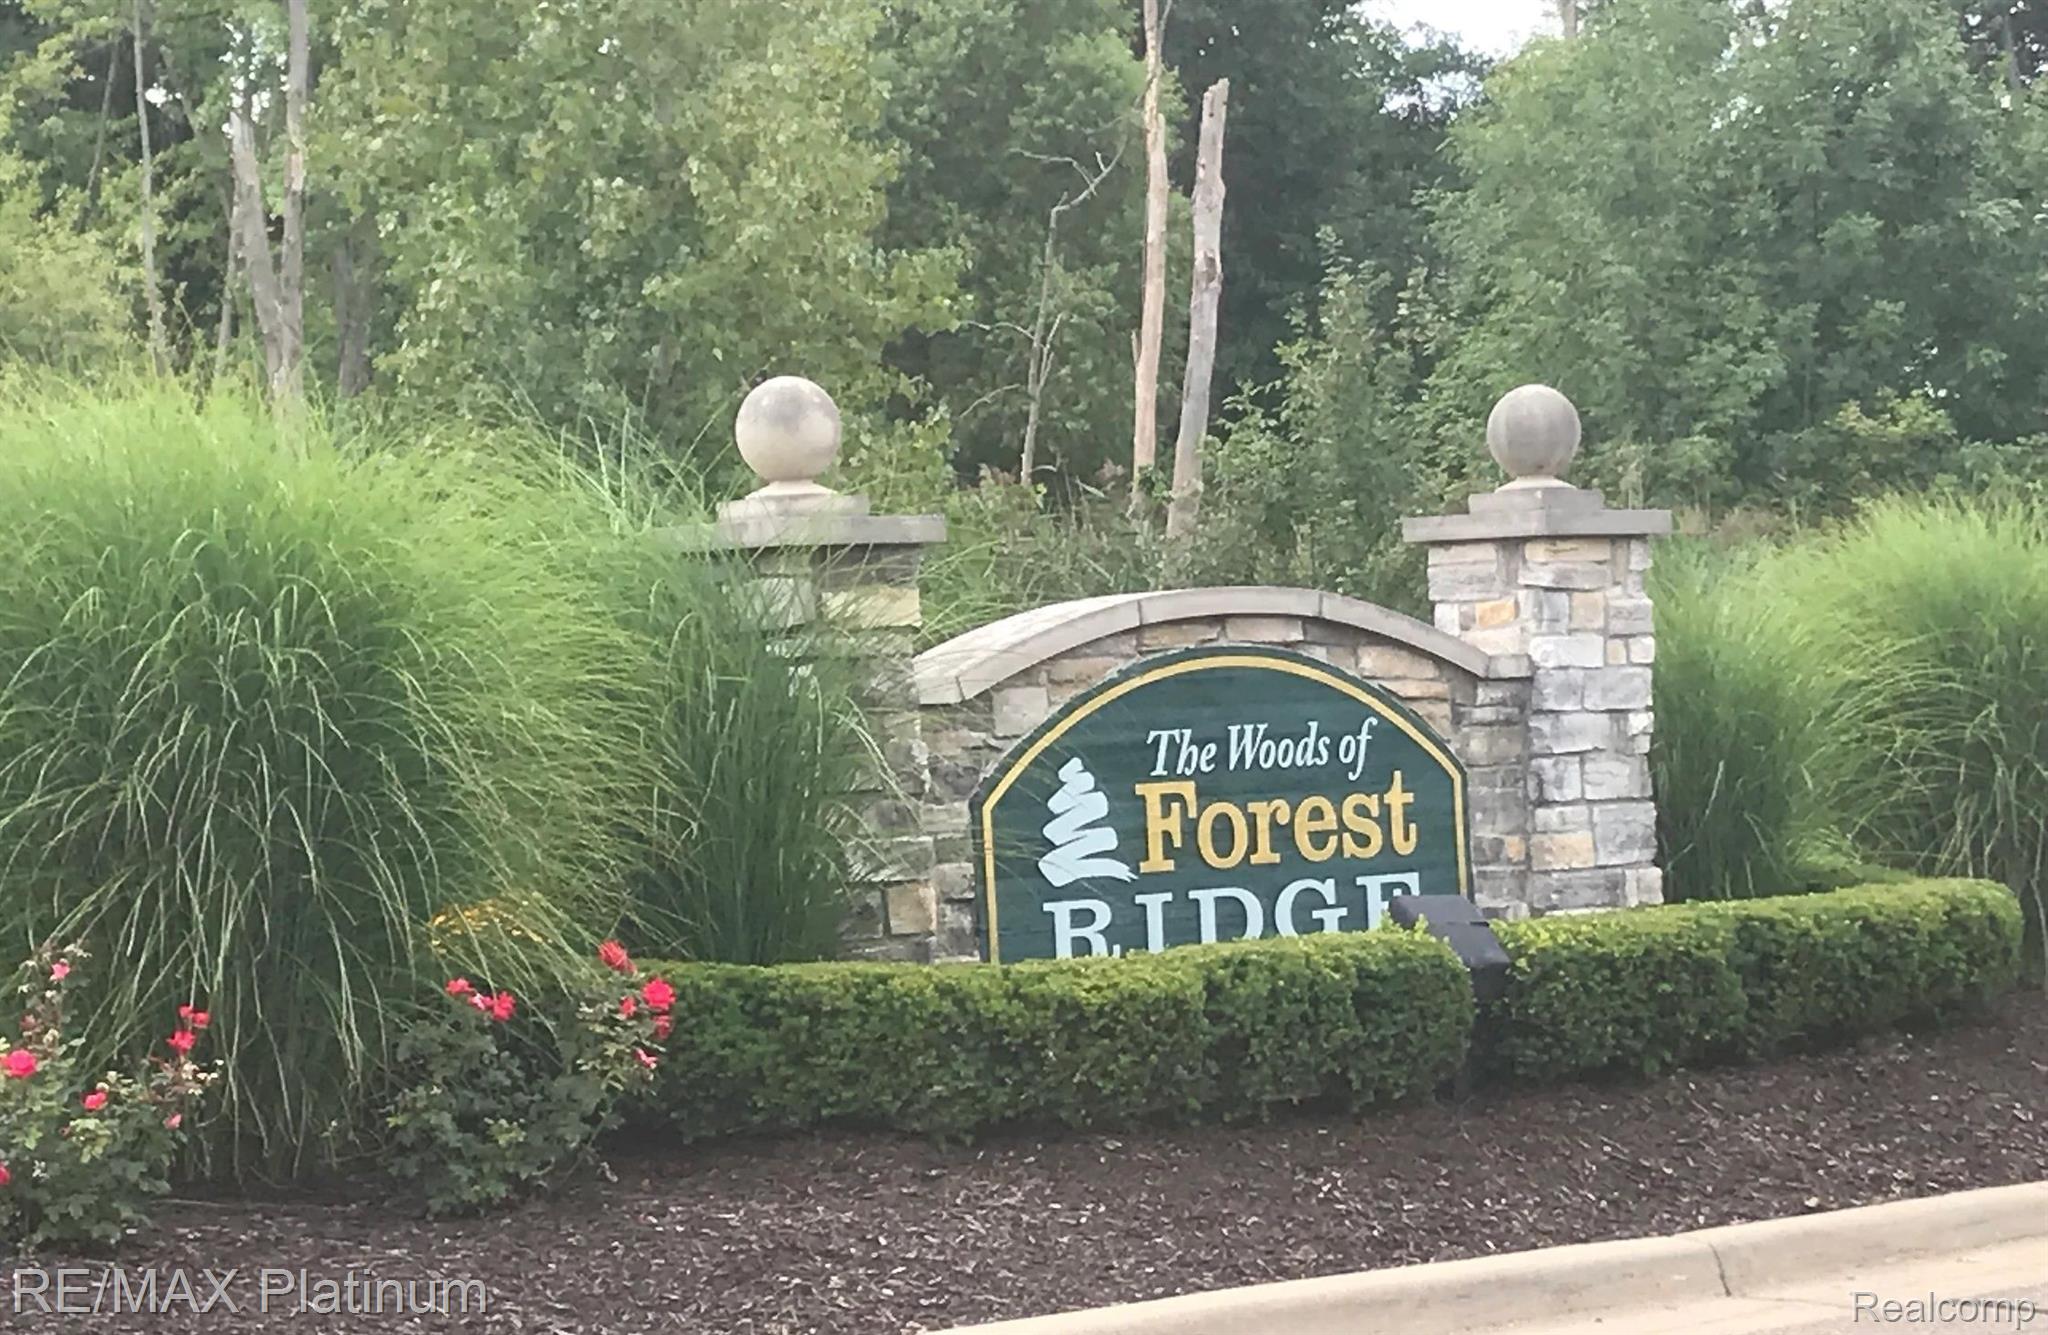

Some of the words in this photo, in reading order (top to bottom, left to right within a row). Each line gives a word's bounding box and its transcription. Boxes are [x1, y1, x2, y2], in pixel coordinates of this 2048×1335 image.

[1145, 728, 1217, 777] The
[1226, 720, 1331, 772] Woods
[1338, 716, 1378, 781] of
[1134, 770, 1418, 874] Forest
